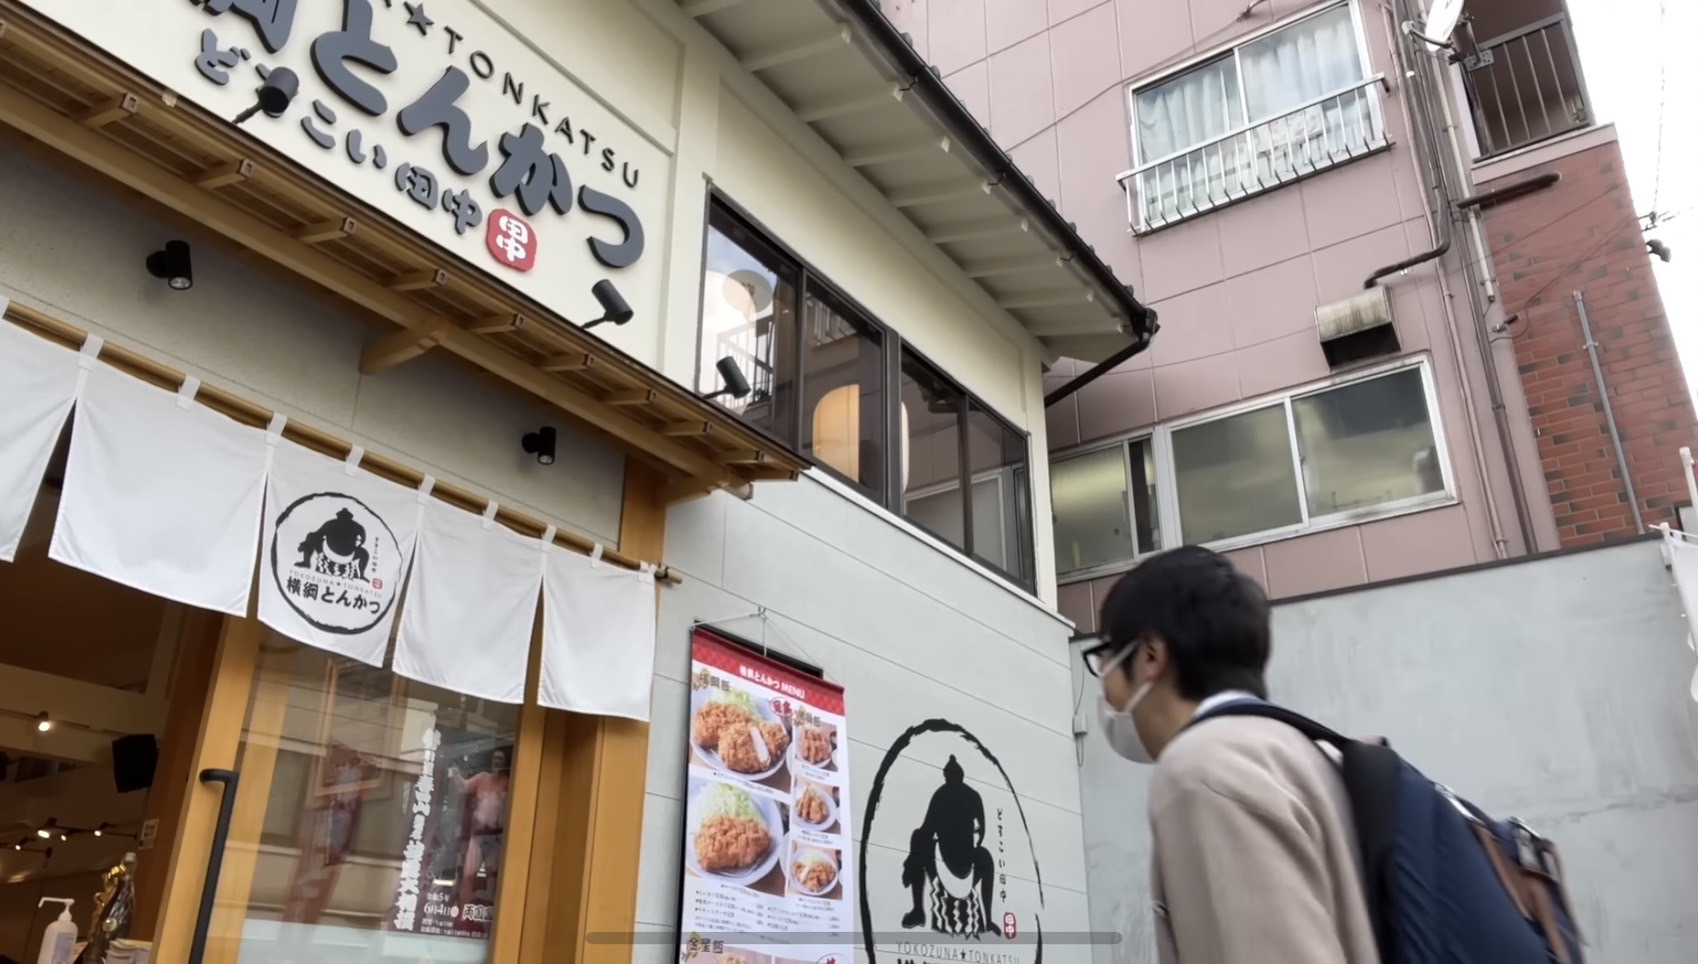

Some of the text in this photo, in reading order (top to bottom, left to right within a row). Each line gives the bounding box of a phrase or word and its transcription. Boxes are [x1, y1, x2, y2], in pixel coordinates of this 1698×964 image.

[443, 25, 641, 189] TONKATSU
[194, 27, 483, 236] どこい田中
[497, 214, 530, 262] 田中
[286, 575, 382, 615] 横綱とんかつ
[781, 682, 806, 699] MENU
[997, 807, 1007, 904] どすこい田中
[896, 941, 958, 959] YOKOZUNA
